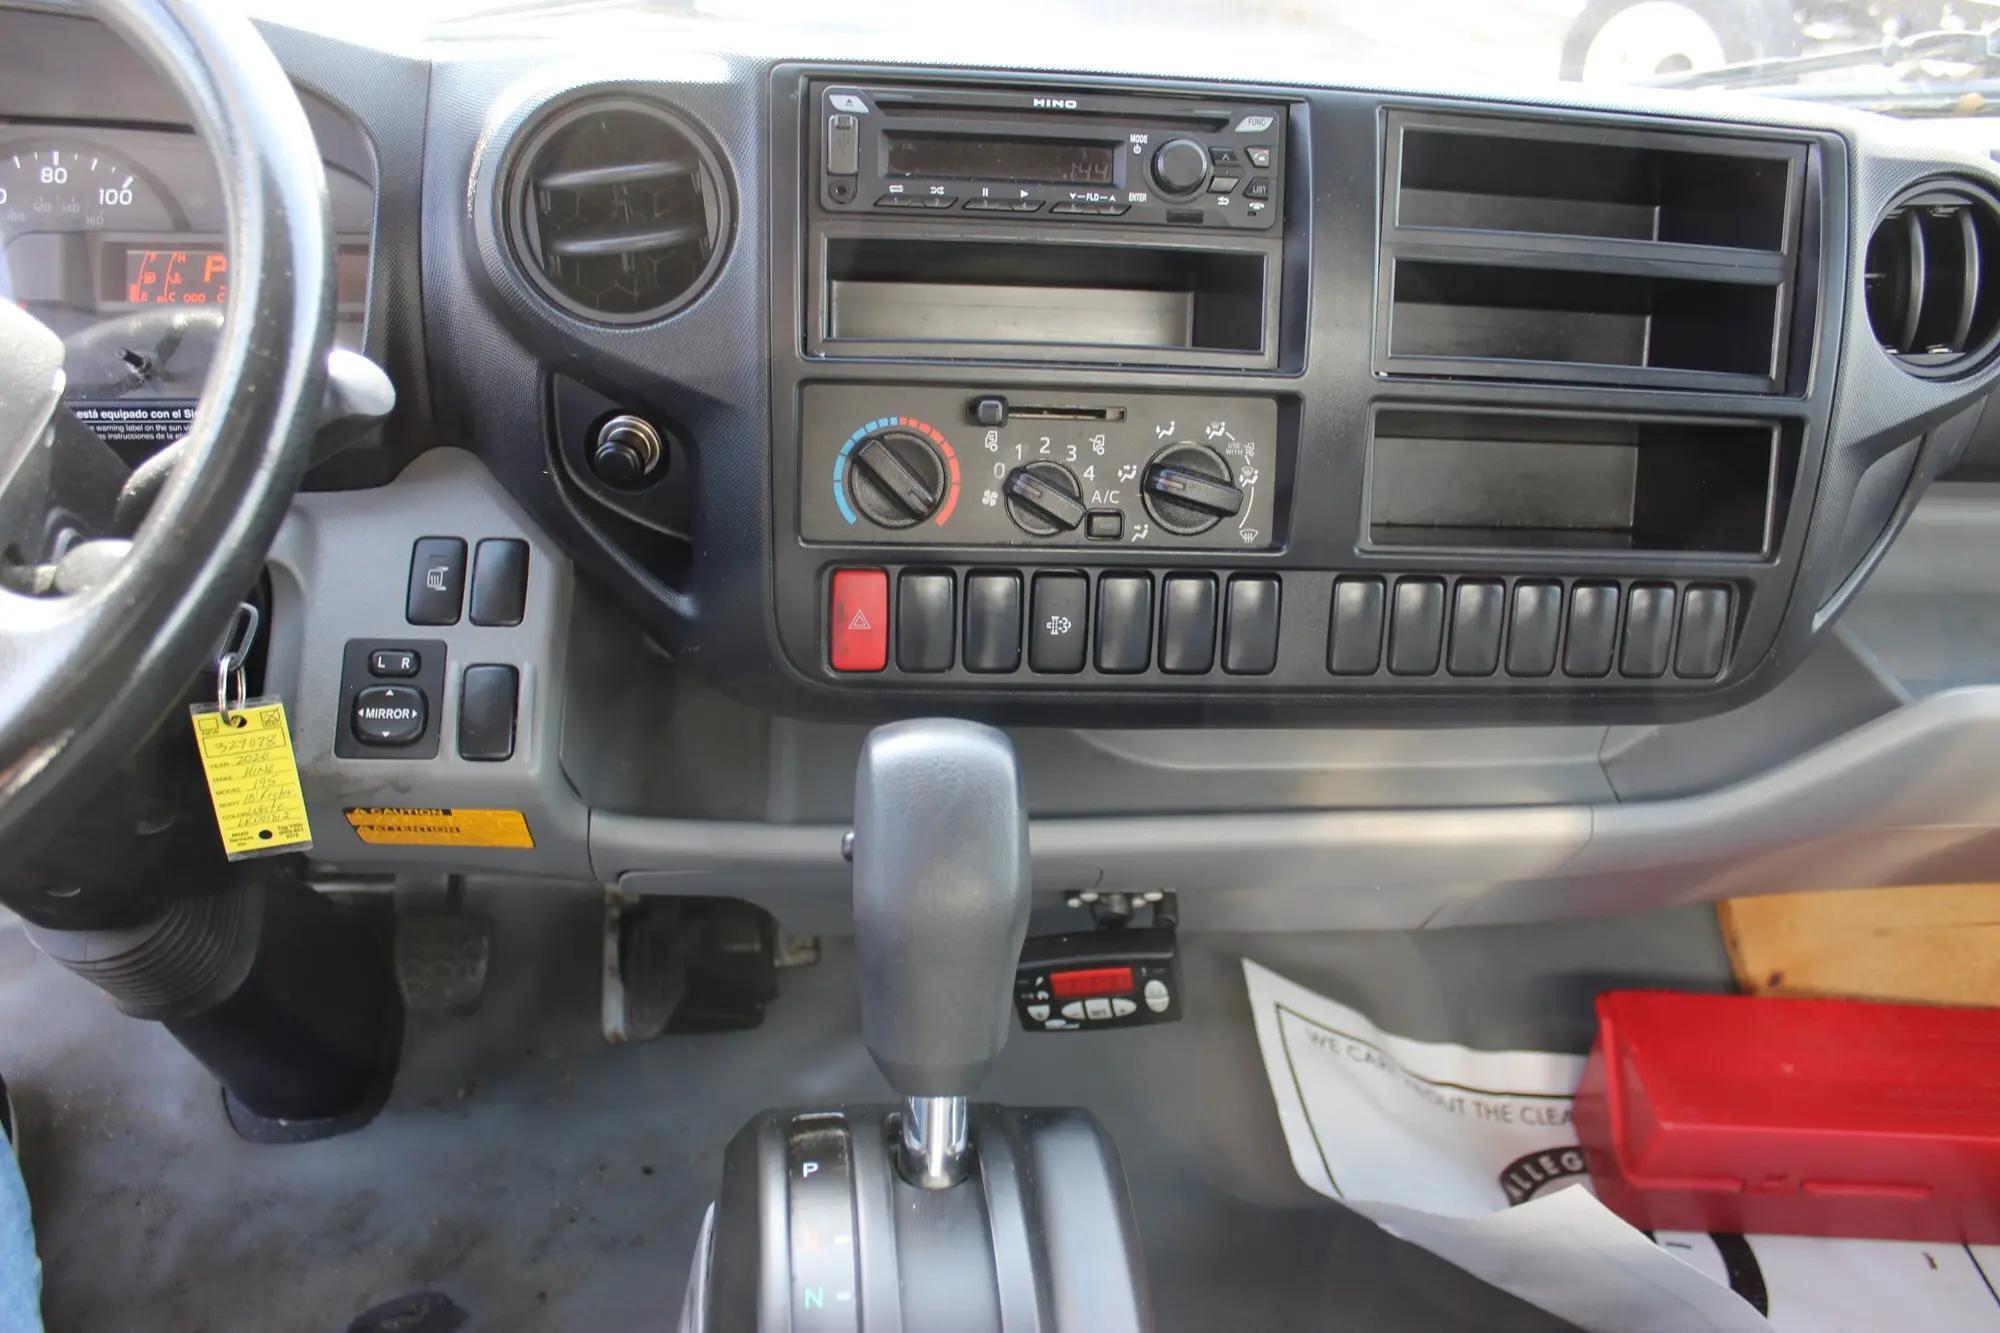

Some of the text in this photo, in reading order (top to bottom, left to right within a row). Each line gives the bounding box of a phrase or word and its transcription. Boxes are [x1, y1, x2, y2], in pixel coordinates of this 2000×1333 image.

[1032, 98, 1078, 110] HINO
[1247, 117, 1267, 127] FUNC
[1129, 134, 1149, 145] MODE
[40, 166, 68, 184] 80
[1086, 192, 1099, 201] FLD
[1252, 185, 1267, 195] LIST
[99, 188, 133, 206] 100
[1128, 193, 1147, 202] ENTER
[203, 254, 227, 283] P
[77, 409, 98, 419] está
[101, 408, 148, 420] equipado
[150, 410, 170, 419] con
[172, 409, 181, 419] el
[126, 424, 143, 432] label
[1014, 443, 1022, 460] 1
[1039, 436, 1050, 454] 2
[1066, 445, 1077, 461] 3
[1083, 465, 1095, 481] 4
[1091, 490, 1120, 504] A/C
[378, 656, 410, 668] L R
[365, 708, 410, 720] MIRROR
[370, 808, 443, 816] CAUTION
[1304, 1027, 1341, 1055] WE
[1474, 1101, 1513, 1123] THE
[1519, 1104, 1573, 1126] CLEA
[803, 1162, 818, 1177] P
[803, 1287, 824, 1310] N
